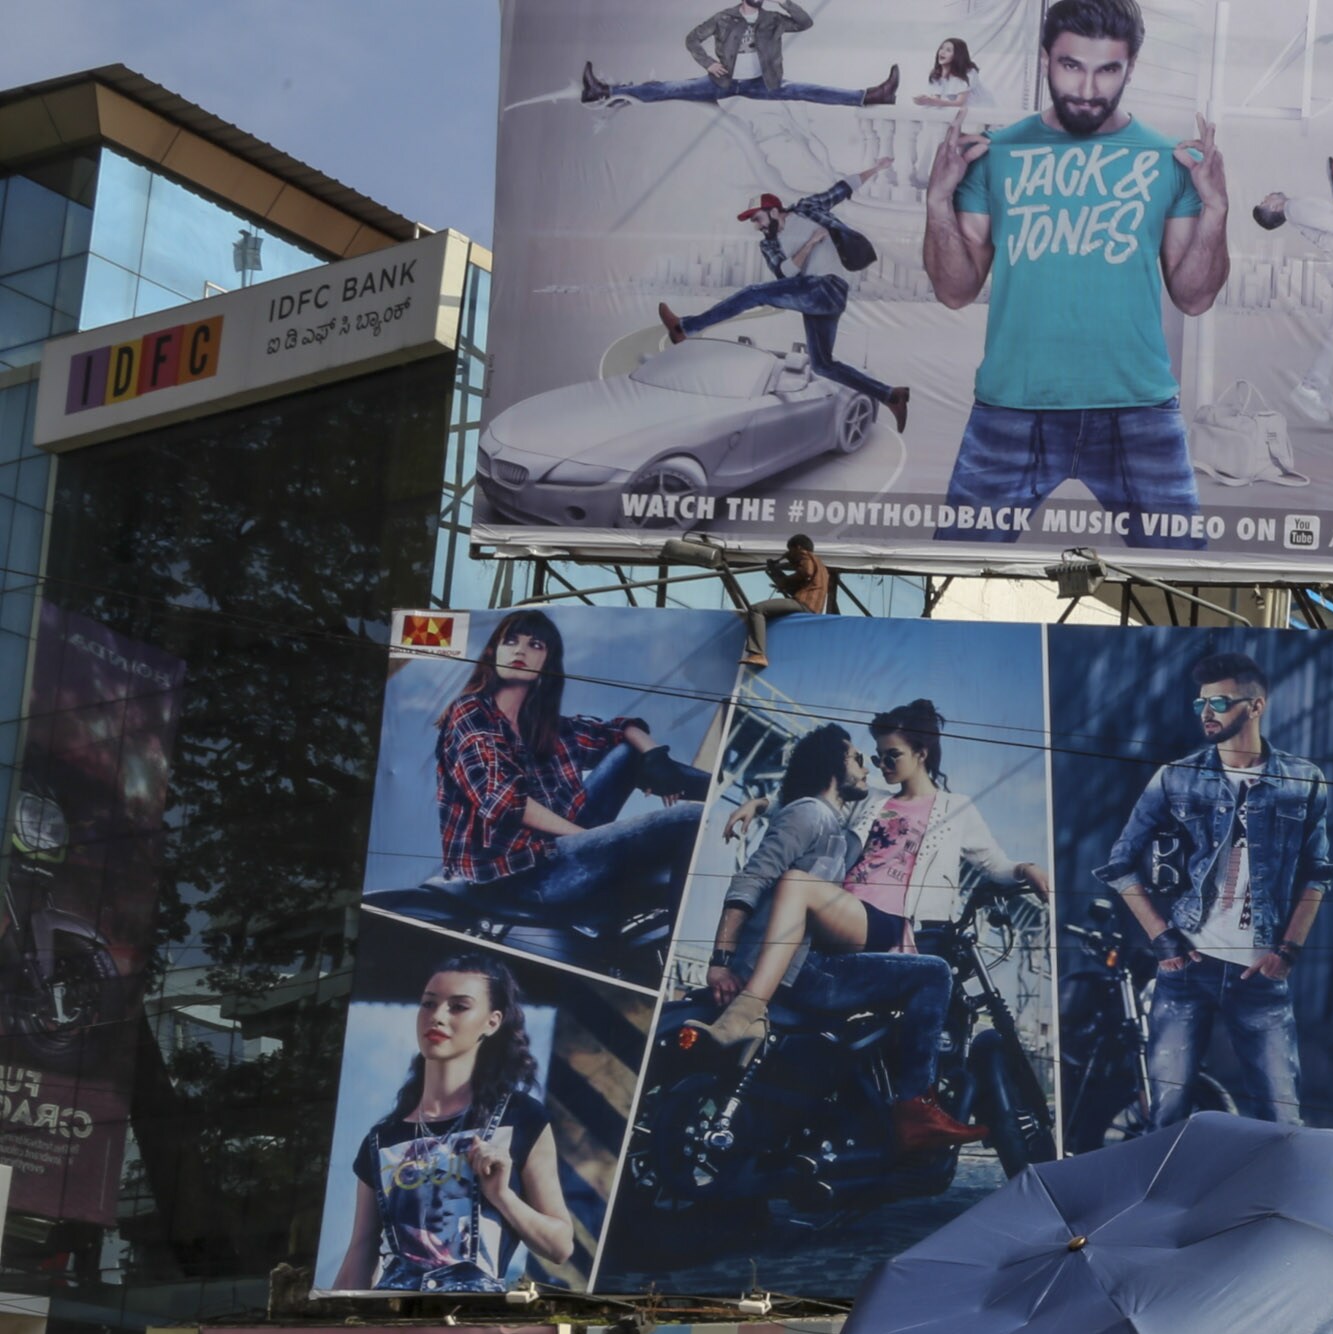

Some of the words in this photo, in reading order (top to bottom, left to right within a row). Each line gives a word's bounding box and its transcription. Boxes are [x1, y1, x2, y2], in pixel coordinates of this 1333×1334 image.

[1005, 144, 1129, 205] JACK
[1112, 150, 1160, 202] &
[1007, 200, 1145, 267] JONES
[268, 284, 331, 323] IDFC
[342, 259, 418, 303] BANK
[81, 323, 211, 406] IDFC
[621, 493, 715, 521] WATCH
[726, 497, 776, 522] THE
[788, 499, 1031, 533] #DONTHOLDBACK
[1042, 508, 1131, 537] MUSIC
[1142, 512, 1225, 540] VIDEO
[1237, 516, 1277, 543] ON
[1290, 530, 1314, 545] Tube
[1294, 518, 1311, 530] You
